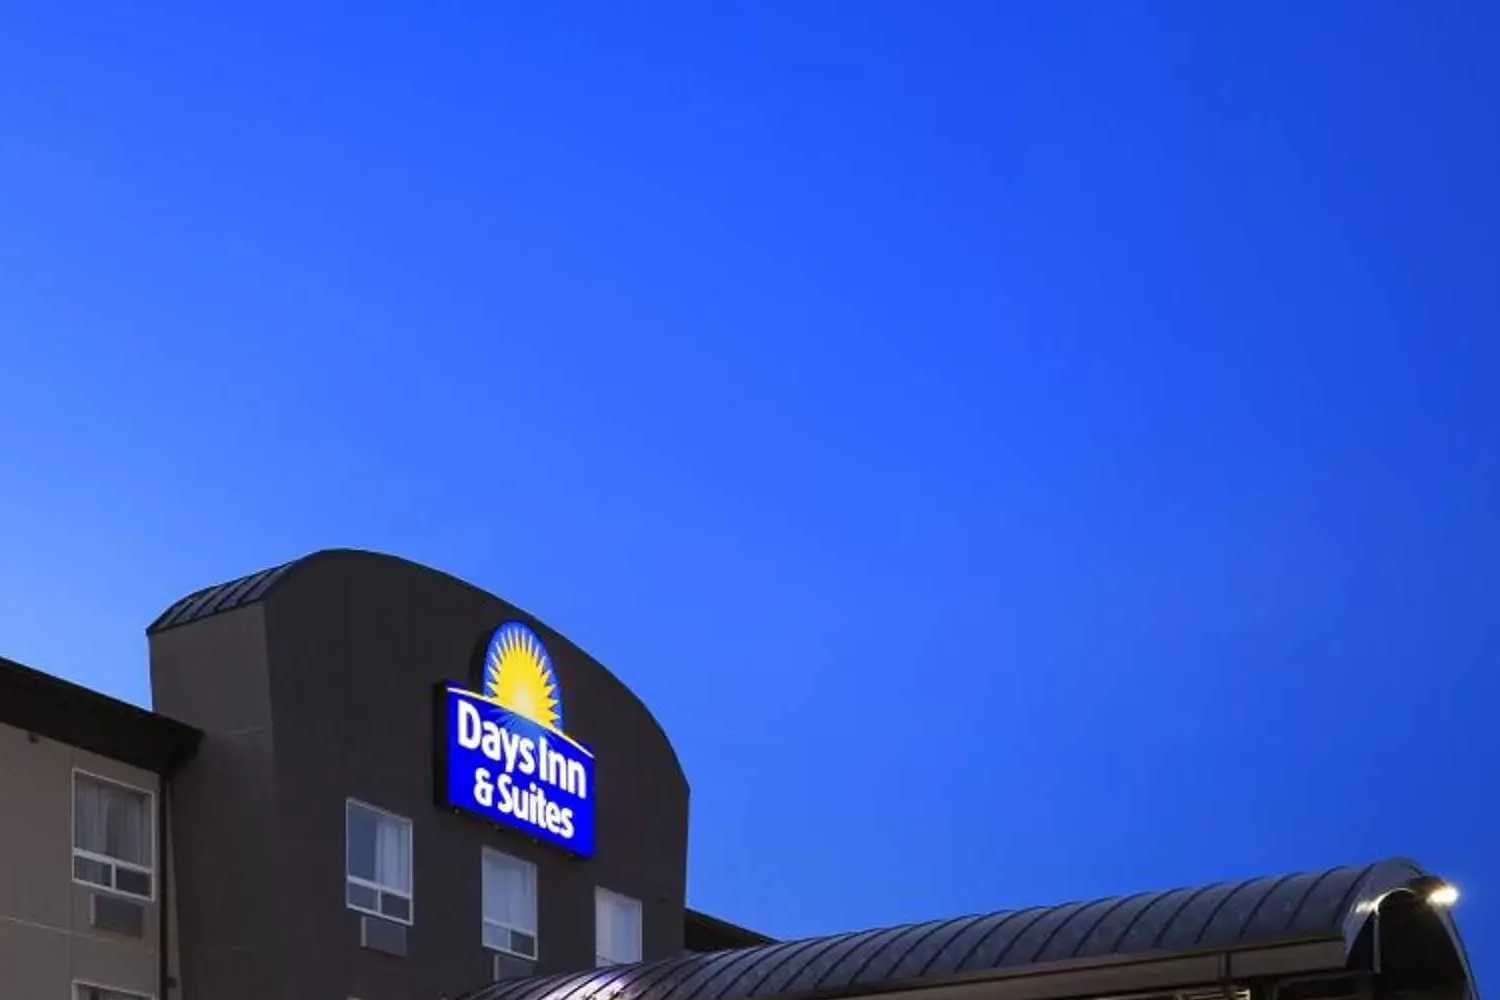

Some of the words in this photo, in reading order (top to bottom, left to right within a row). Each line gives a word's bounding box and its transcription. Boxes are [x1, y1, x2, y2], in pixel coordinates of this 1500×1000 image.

[457, 699, 535, 774] Days
[539, 737, 587, 799] Inn
[473, 767, 494, 807] &
[497, 773, 575, 839] Suites
